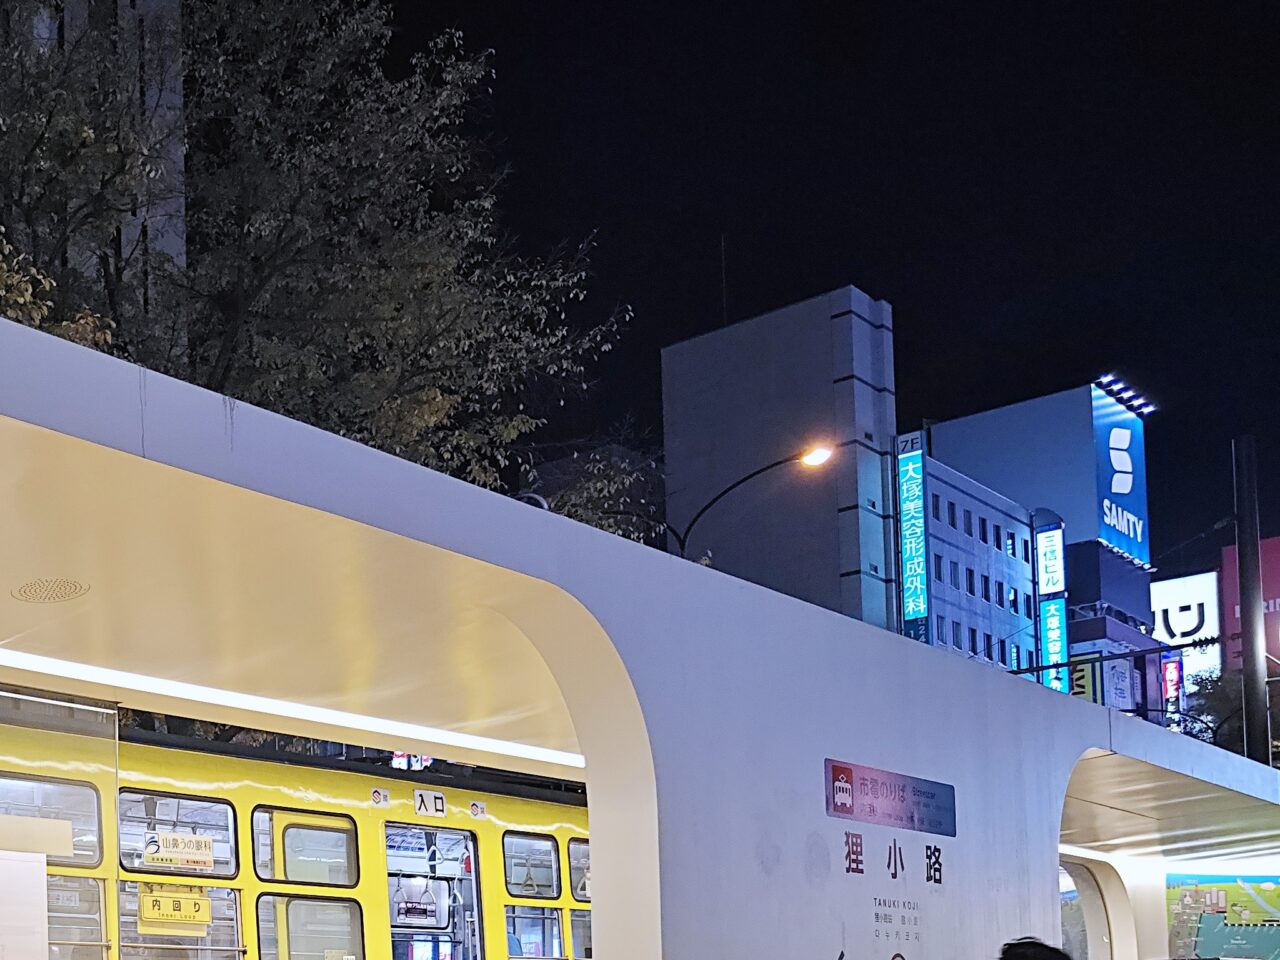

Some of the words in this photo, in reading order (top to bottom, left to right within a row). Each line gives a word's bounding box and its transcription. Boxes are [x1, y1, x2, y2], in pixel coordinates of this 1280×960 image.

[899, 437, 920, 452] 7F
[1103, 498, 1144, 543] SAMTY
[900, 460, 927, 616] 大塚美容形成外科
[418, 793, 445, 813] 入口
[844, 831, 943, 885] 狸小路
[152, 899, 201, 913] 内回り
[873, 897, 900, 909] TANUKI
[902, 900, 919, 911] KOJI
